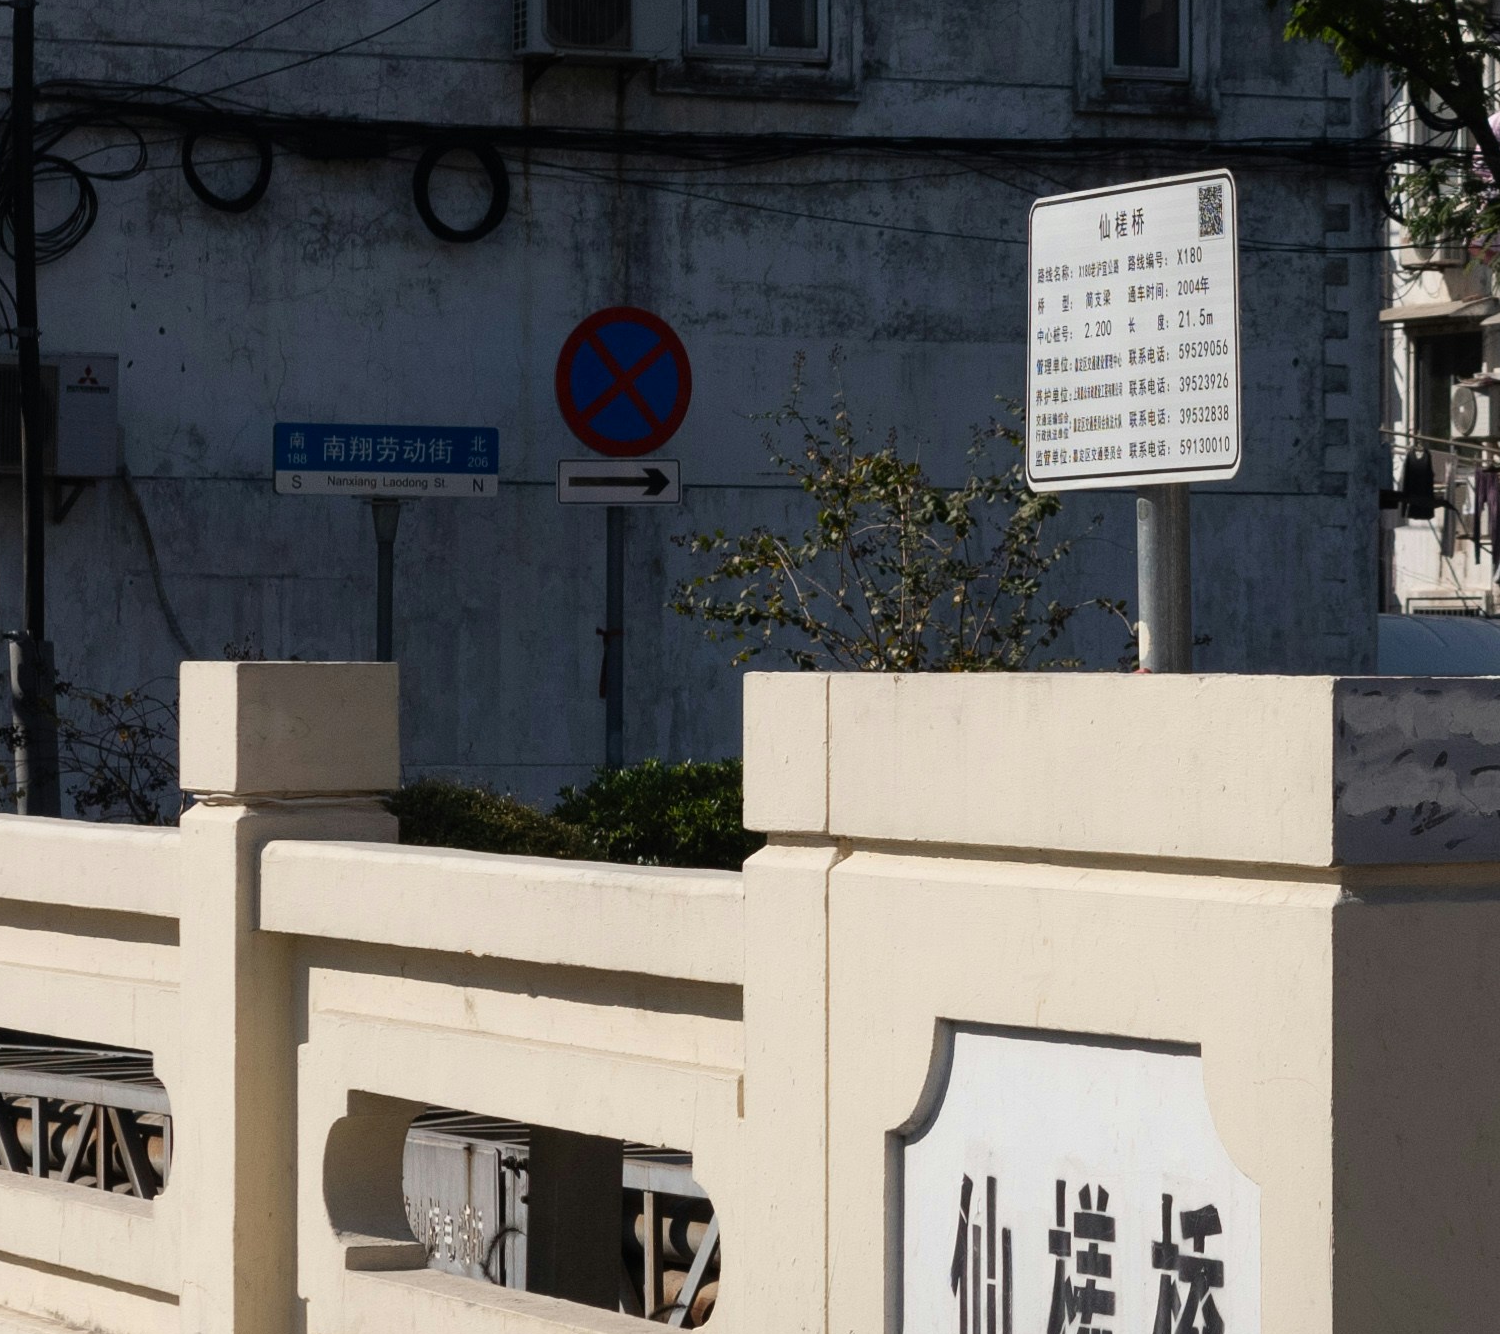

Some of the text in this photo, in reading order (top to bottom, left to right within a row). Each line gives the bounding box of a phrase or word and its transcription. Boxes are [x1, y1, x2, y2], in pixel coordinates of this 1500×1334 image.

[1099, 207, 1145, 240] 仙槎桥
[1177, 247, 1202, 265] X180
[1085, 290, 1111, 308] 简支梁
[1177, 276, 1210, 296] 2004年
[1085, 319, 1112, 339] 2.200
[1178, 309, 1213, 328] 21.5m
[1178, 339, 1229, 359] 59529056
[1179, 373, 1229, 392] 39523926
[1179, 405, 1229, 424] 39532838
[290, 431, 305, 449] 南
[323, 435, 453, 463] 南翔劳动街
[470, 436, 487, 453] 北
[1180, 437, 1230, 455] 59130010
[286, 453, 307, 464] 188
[468, 456, 488, 468] 206
[292, 475, 302, 490] S
[327, 476, 377, 490] Nanxiang
[383, 477, 428, 490] Laodong
[473, 478, 484, 492] N
